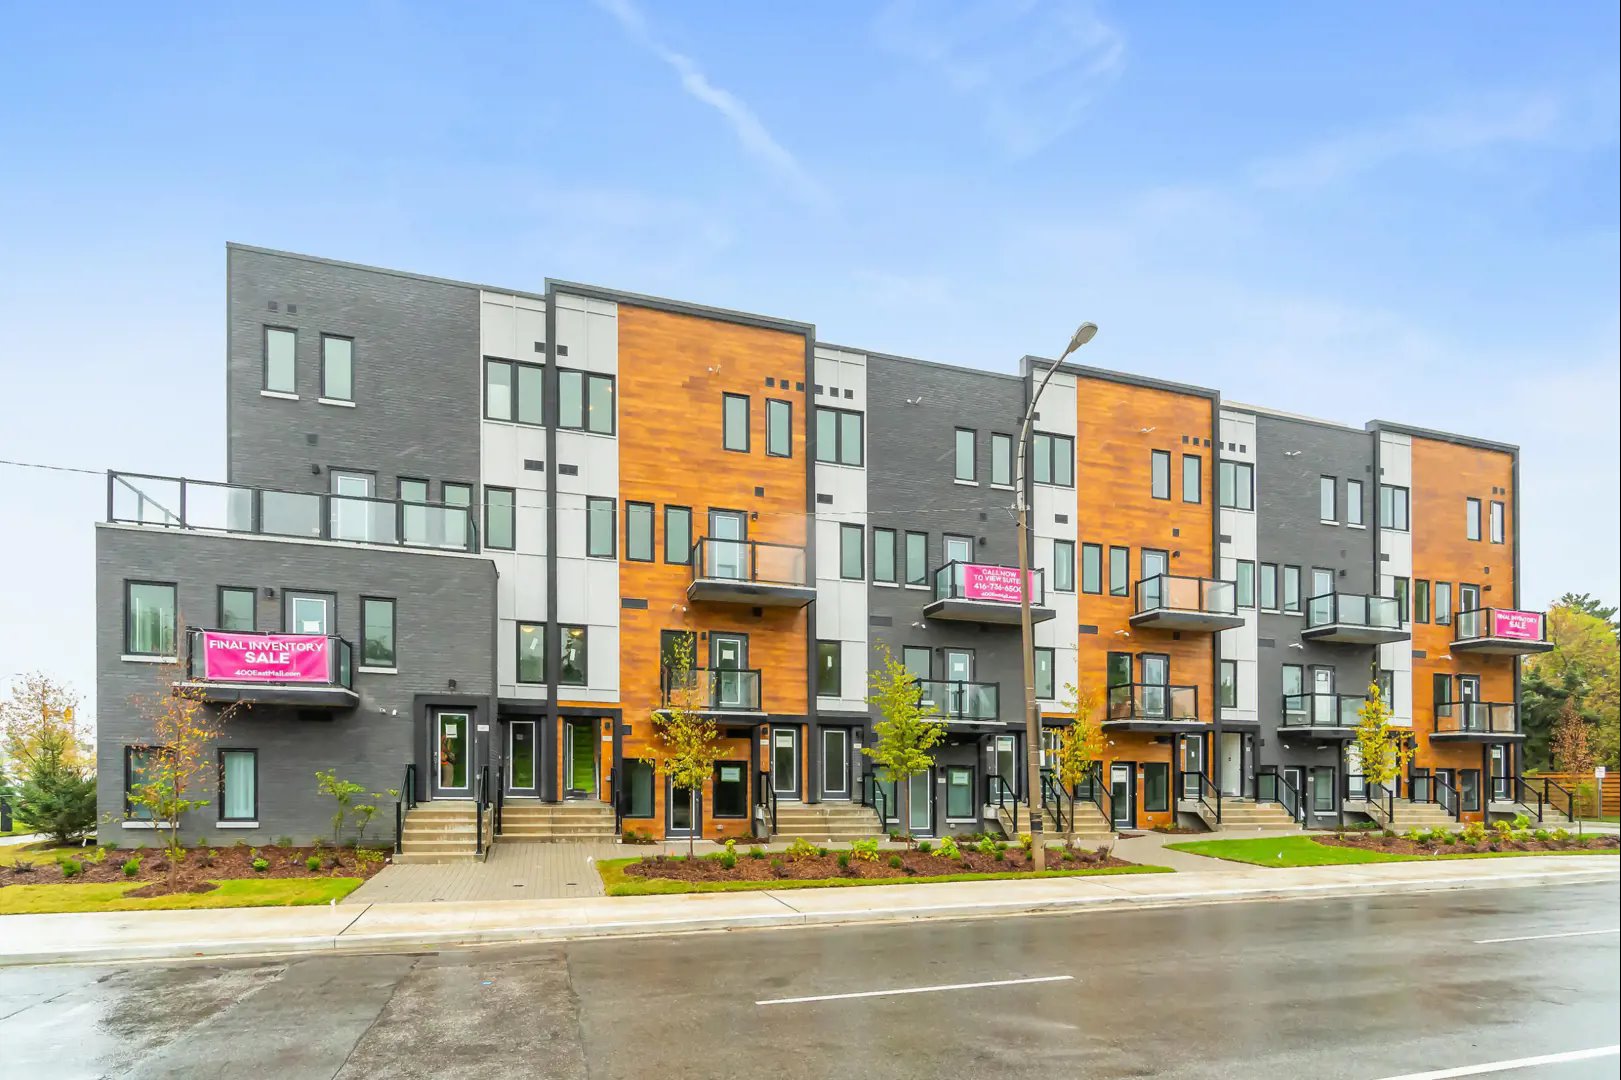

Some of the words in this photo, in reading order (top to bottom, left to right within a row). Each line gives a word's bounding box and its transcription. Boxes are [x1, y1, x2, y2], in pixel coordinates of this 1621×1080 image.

[1509, 621, 1526, 629] SALE
[209, 640, 246, 650] FINAL
[249, 641, 323, 652] INVENTORY
[245, 651, 290, 664] SALE
[234, 669, 301, 677] 400EastMall.com
